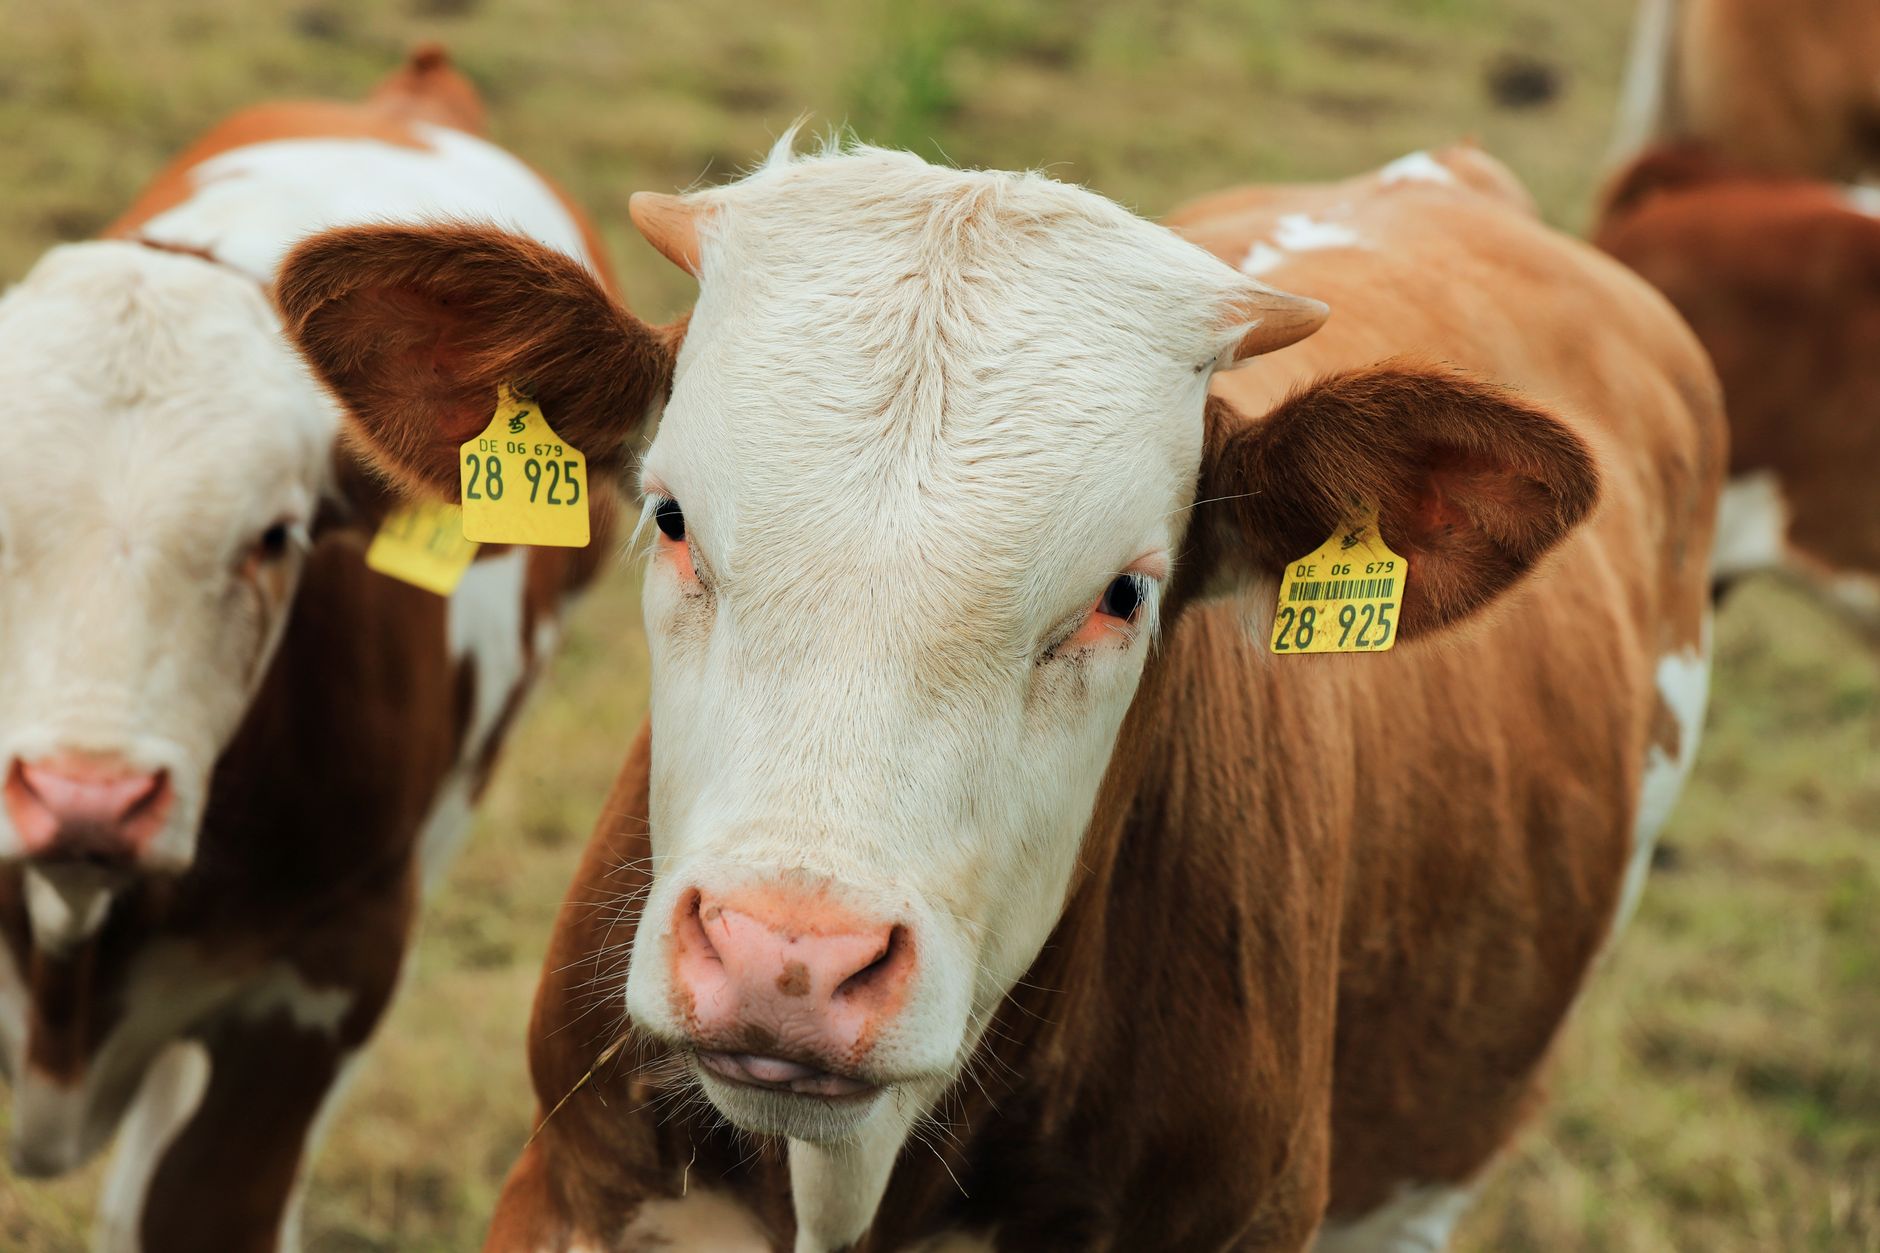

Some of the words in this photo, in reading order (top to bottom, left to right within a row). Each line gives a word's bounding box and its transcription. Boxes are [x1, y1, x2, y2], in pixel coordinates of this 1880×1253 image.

[479, 438, 498, 453] DE
[506, 441, 526, 454] 06
[534, 444, 563, 457] 679
[466, 453, 503, 501] 28
[524, 458, 580, 506] 925
[1296, 564, 1316, 577] DE
[1331, 563, 1351, 576] 06
[1365, 561, 1394, 574] 679
[1275, 606, 1316, 650] 28
[1337, 603, 1395, 648] 925
